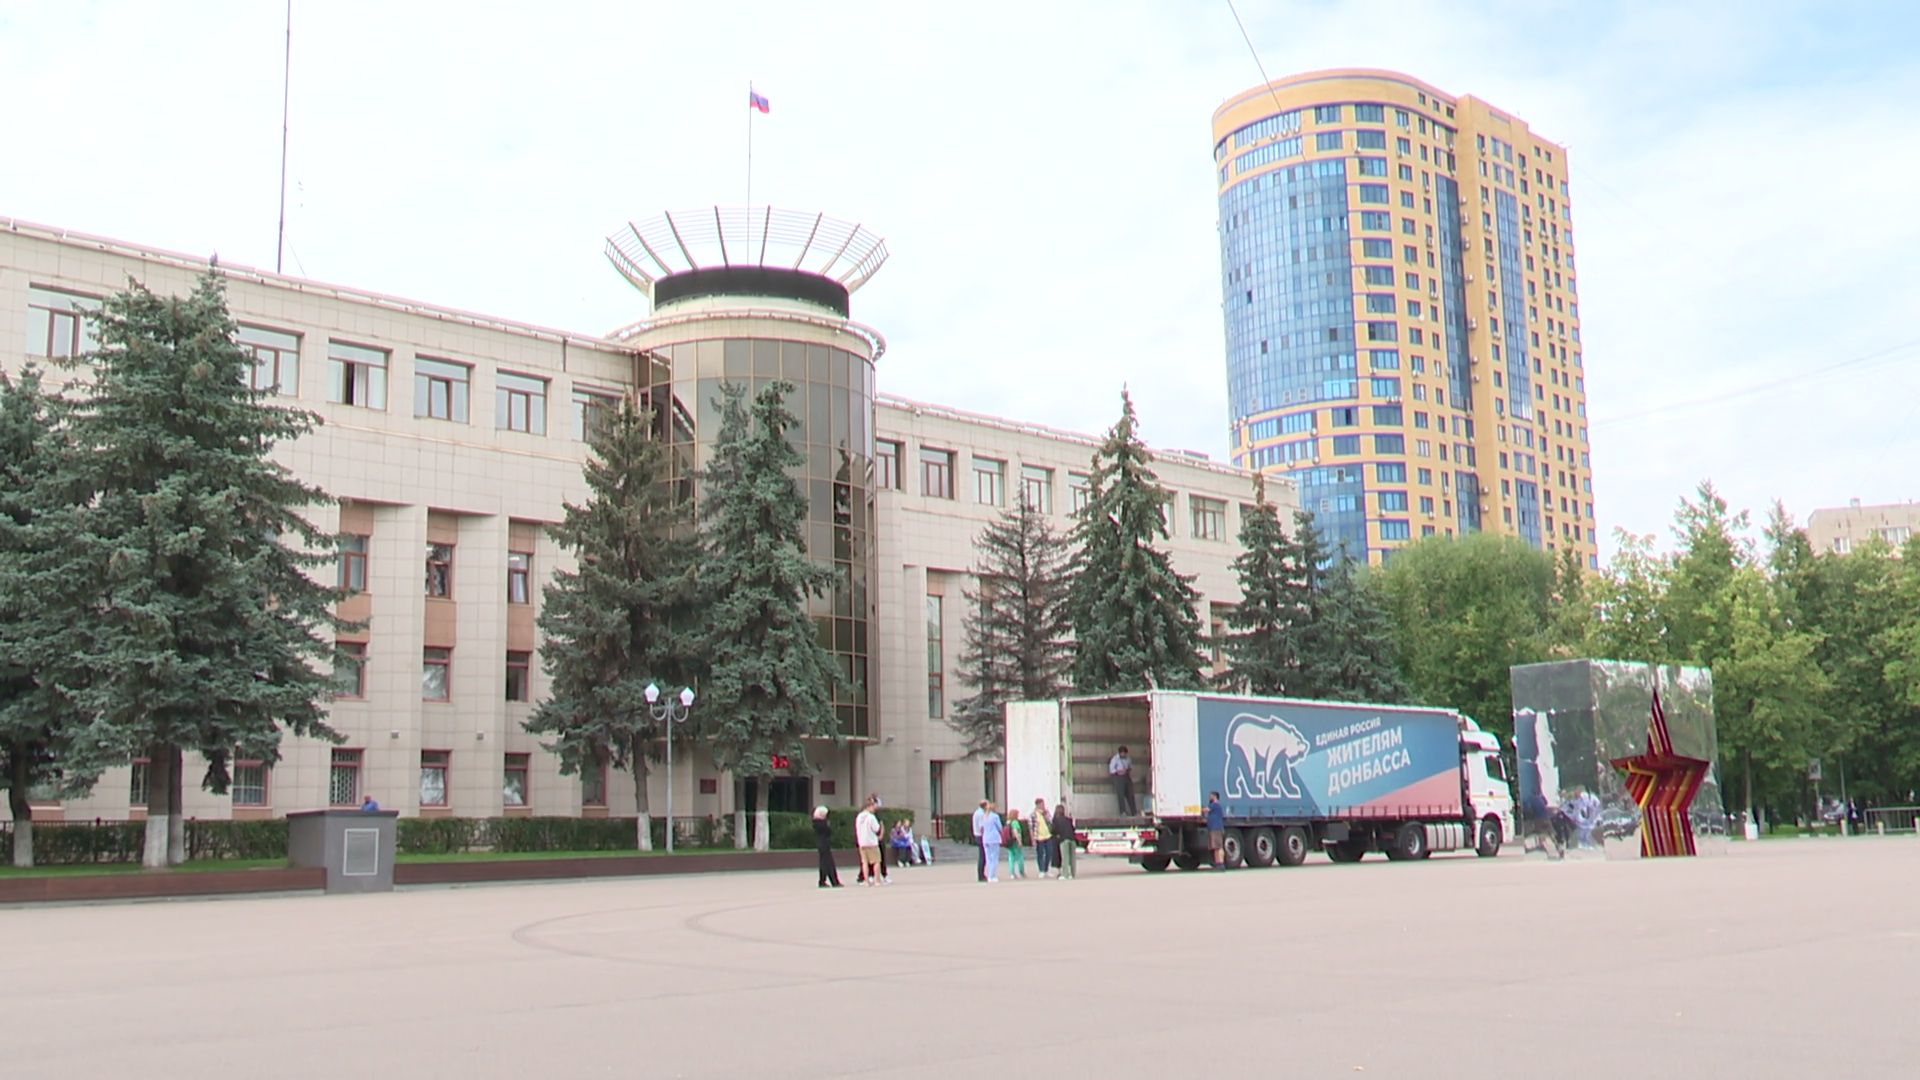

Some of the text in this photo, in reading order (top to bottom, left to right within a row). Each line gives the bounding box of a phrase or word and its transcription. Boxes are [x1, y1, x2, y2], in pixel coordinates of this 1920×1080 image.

[1316, 716, 1381, 746] ЕДИНАЯ РОССИЯ
[1327, 726, 1402, 768] ЖИТЕЛЯМ
[1327, 748, 1411, 797] ДОНБАССА
